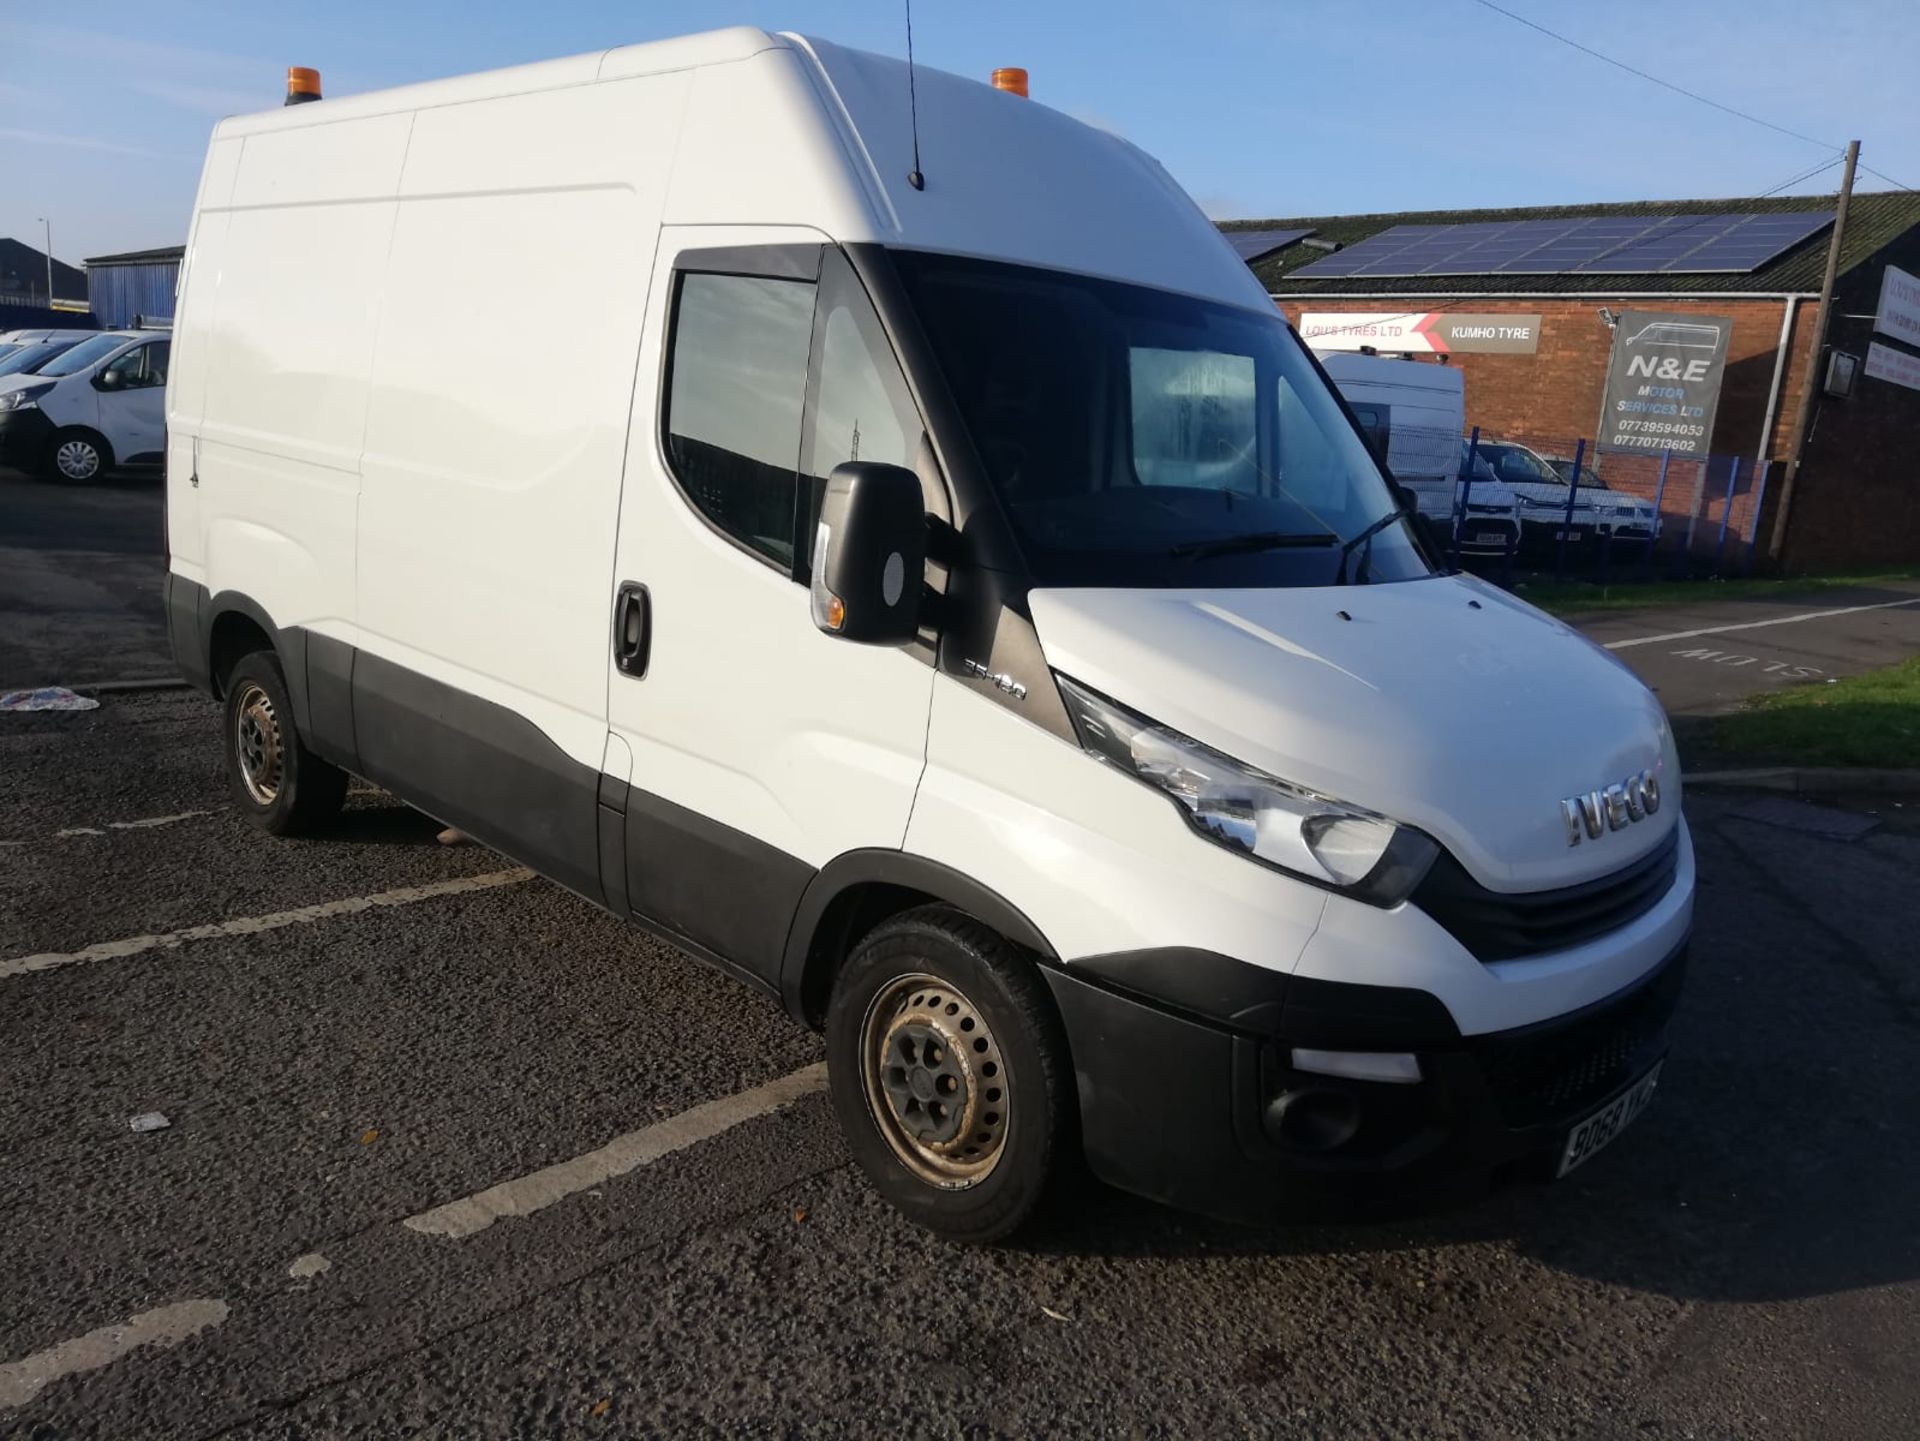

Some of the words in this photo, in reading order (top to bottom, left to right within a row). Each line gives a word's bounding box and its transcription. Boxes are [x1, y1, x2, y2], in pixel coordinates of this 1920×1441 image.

[1341, 326, 1377, 337] TYRES
[1380, 326, 1402, 337] LTD
[1451, 326, 1495, 339] KUMHO
[1498, 327, 1530, 339] TYRE
[1626, 355, 1711, 382] N&E
[1638, 385, 1685, 397] MOTOR
[1616, 400, 1678, 416] SERVICES
[1680, 405, 1704, 417] LTD
[1618, 419, 1704, 437] 07739594053
[1613, 434, 1696, 451] 07770713602
[1560, 769, 1661, 848] IVECO
